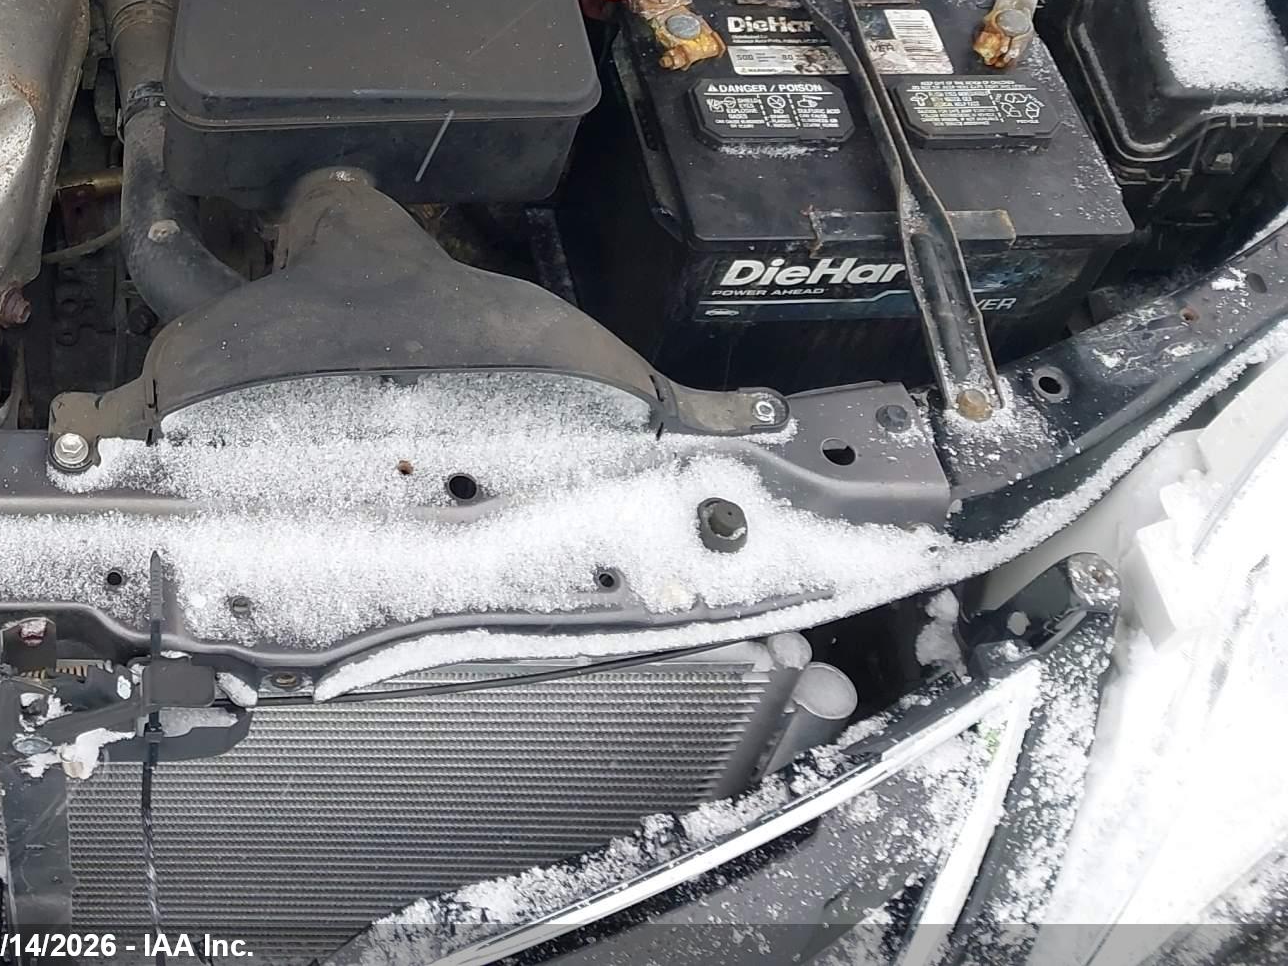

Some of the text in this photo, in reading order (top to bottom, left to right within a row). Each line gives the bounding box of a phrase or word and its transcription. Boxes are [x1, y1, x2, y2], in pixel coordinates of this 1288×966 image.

[727, 16, 814, 33] DieHar
[719, 84, 767, 92] DANGER
[779, 84, 822, 92] POISON
[719, 257, 906, 286] DieHar
[711, 287, 826, 297] POWER AHEAD
